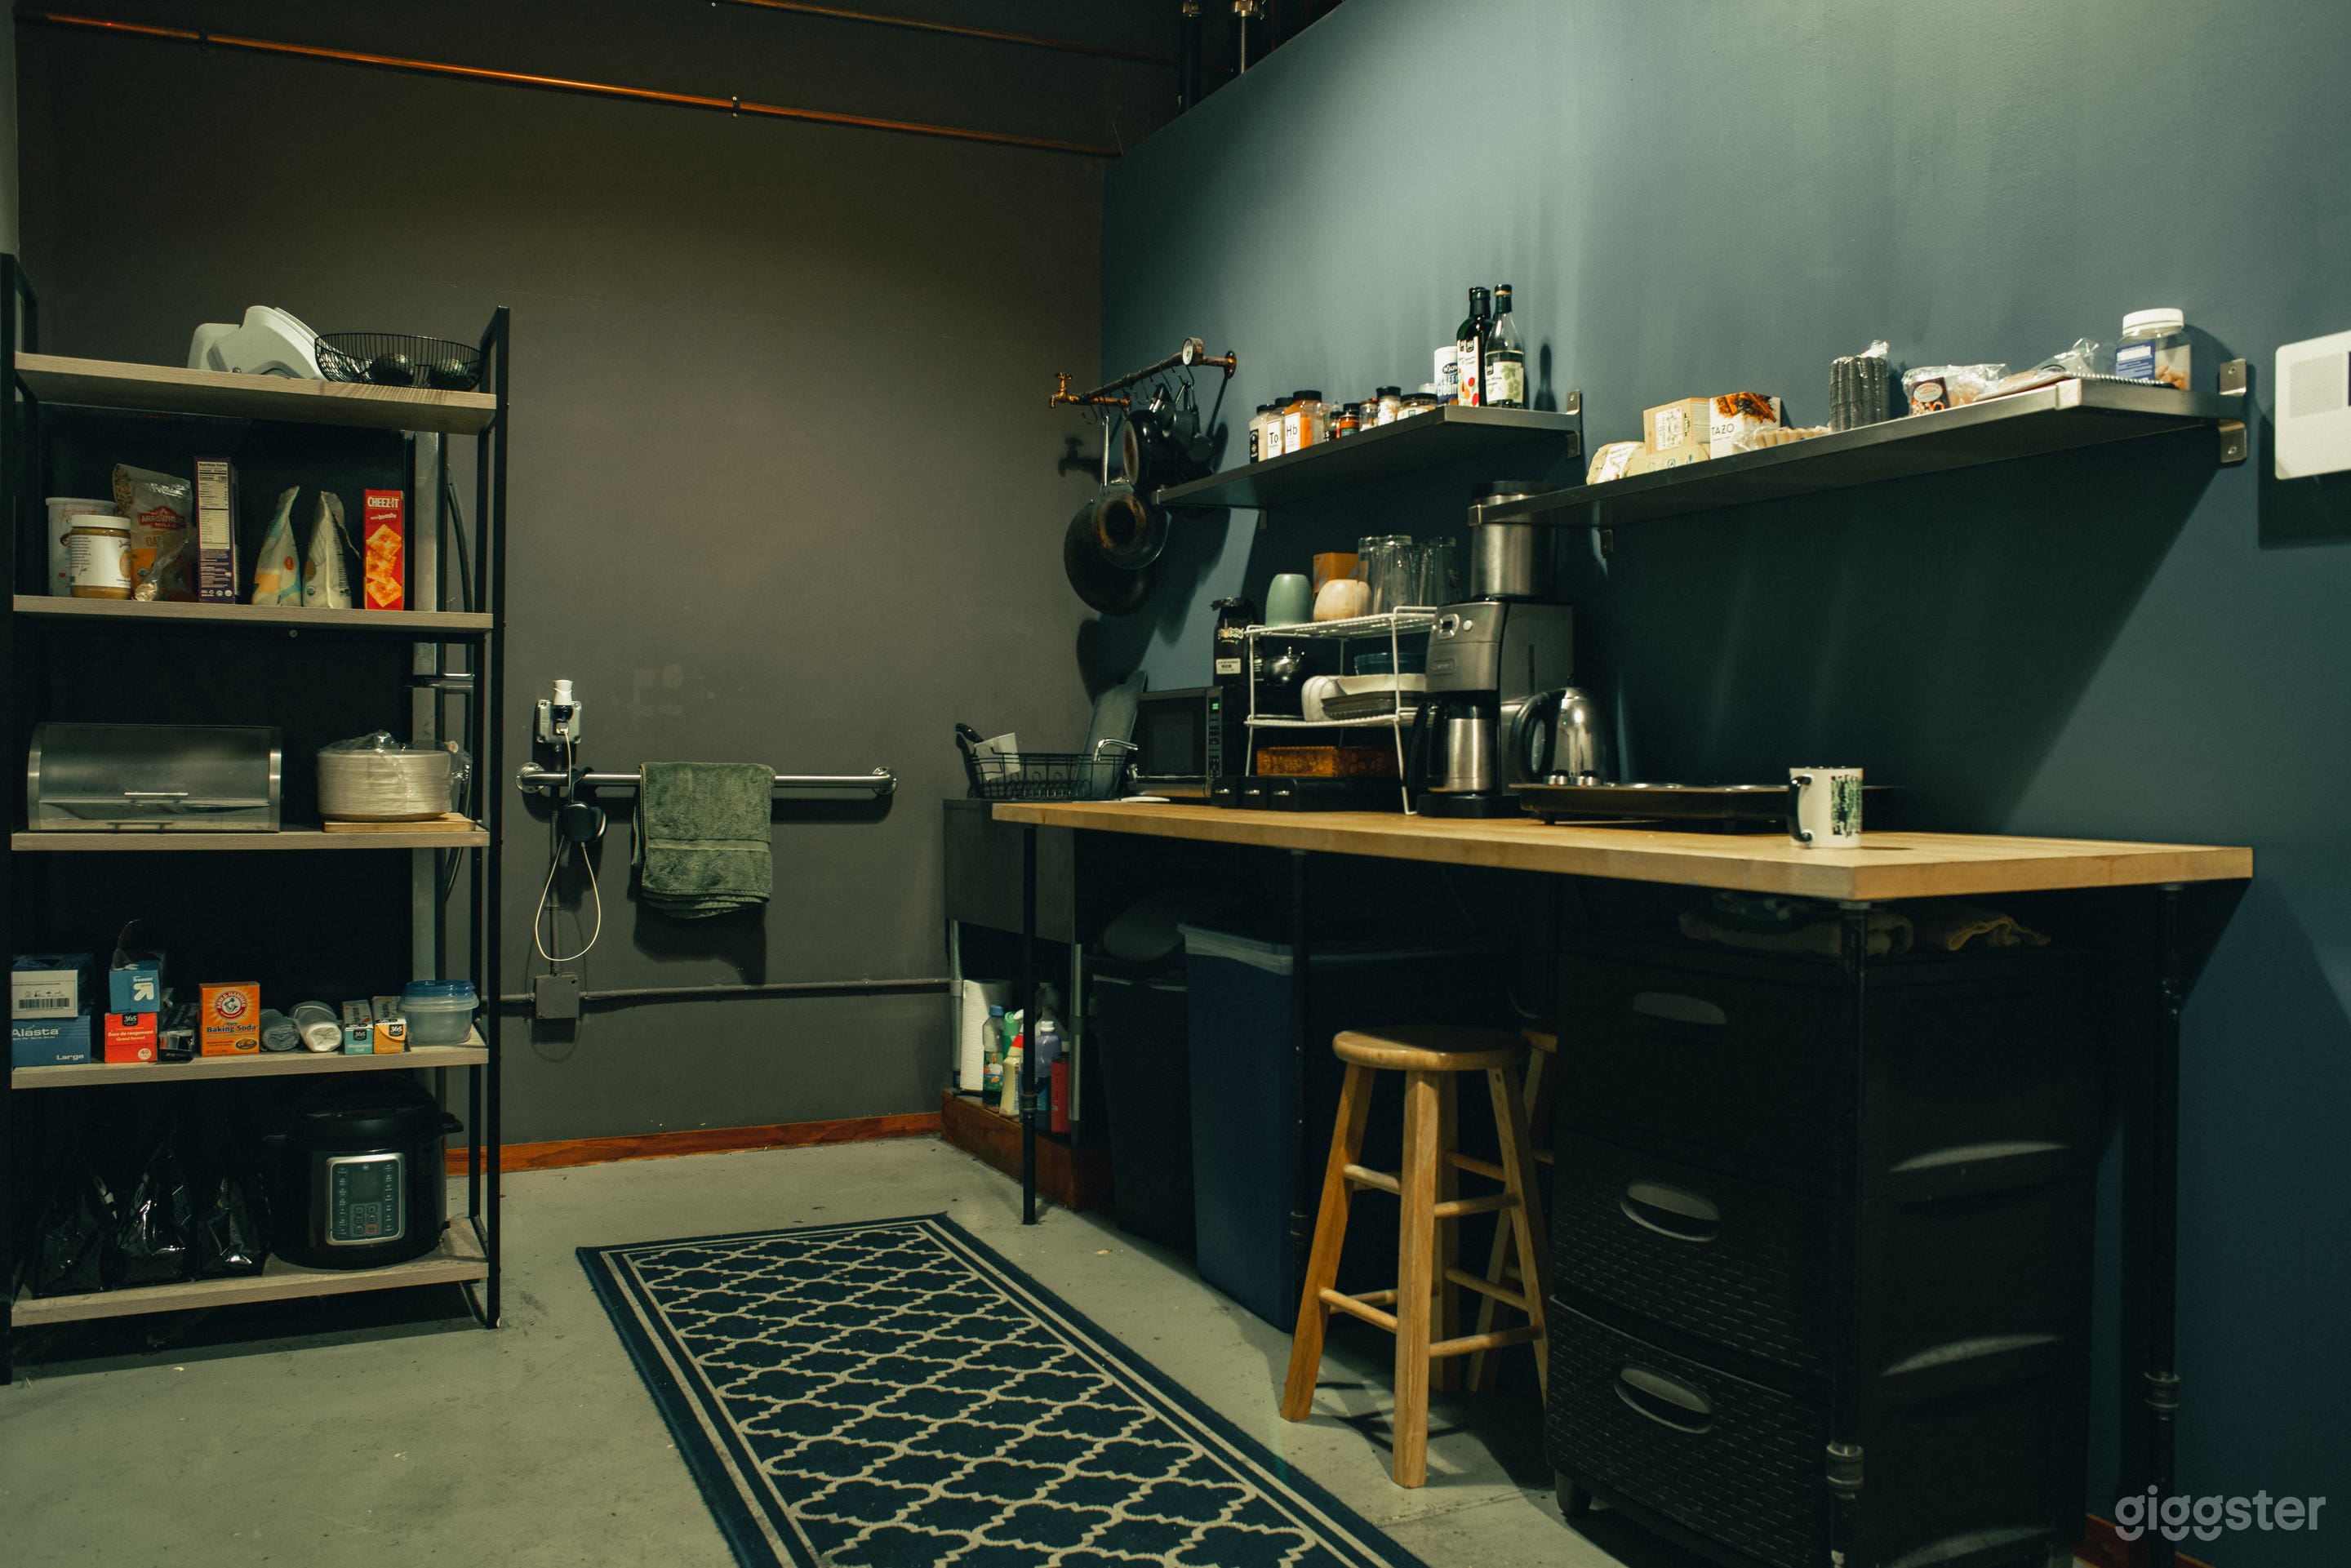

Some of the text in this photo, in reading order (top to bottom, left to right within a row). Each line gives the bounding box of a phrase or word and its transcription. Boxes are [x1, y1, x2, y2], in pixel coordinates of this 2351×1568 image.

[1286, 424, 1298, 437] Hb
[1711, 423, 1735, 434] TAZO
[1269, 432, 1279, 445] To
[367, 496, 400, 509] CHEEZ-IT
